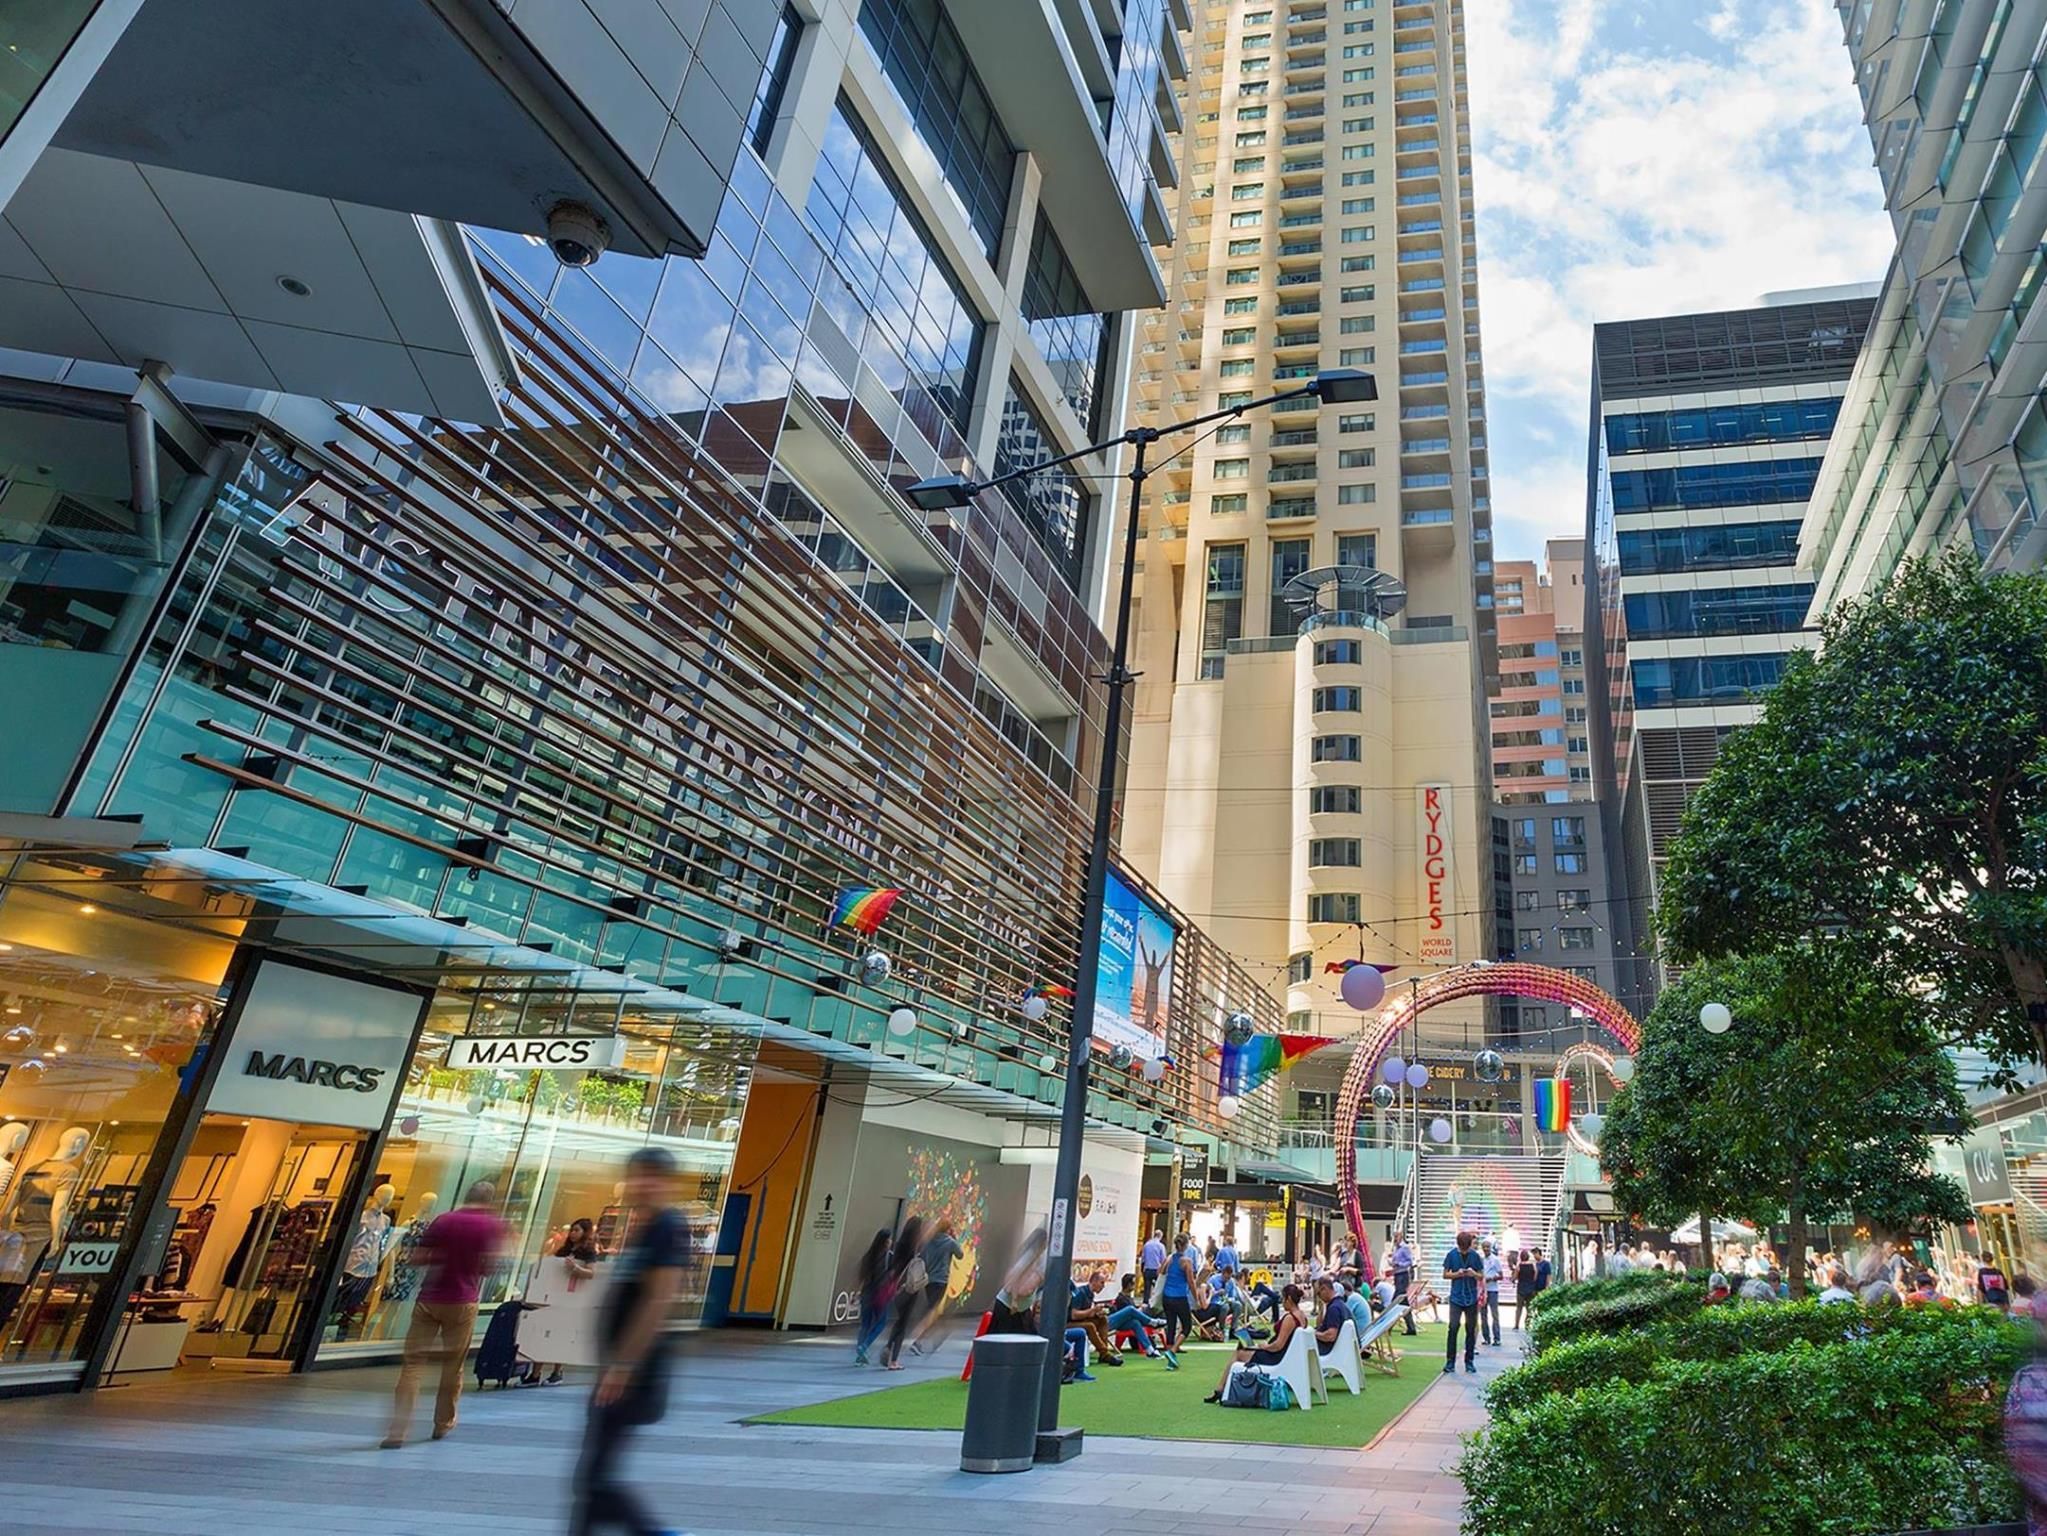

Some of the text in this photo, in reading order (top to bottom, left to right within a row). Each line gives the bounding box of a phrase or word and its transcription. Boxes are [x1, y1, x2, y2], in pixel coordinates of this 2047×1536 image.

[1425, 787, 1445, 930] RYDGES
[1422, 938, 1452, 947] WORLD
[1420, 948, 1453, 958] SQUARE
[468, 1040, 590, 1064] MARCS
[246, 1050, 380, 1093] MARCS
[1973, 1150, 1999, 1184] CUE
[1182, 1179, 1204, 1189] FOOD
[1182, 1189, 1202, 1200] TIME
[69, 1250, 113, 1267] YOU
